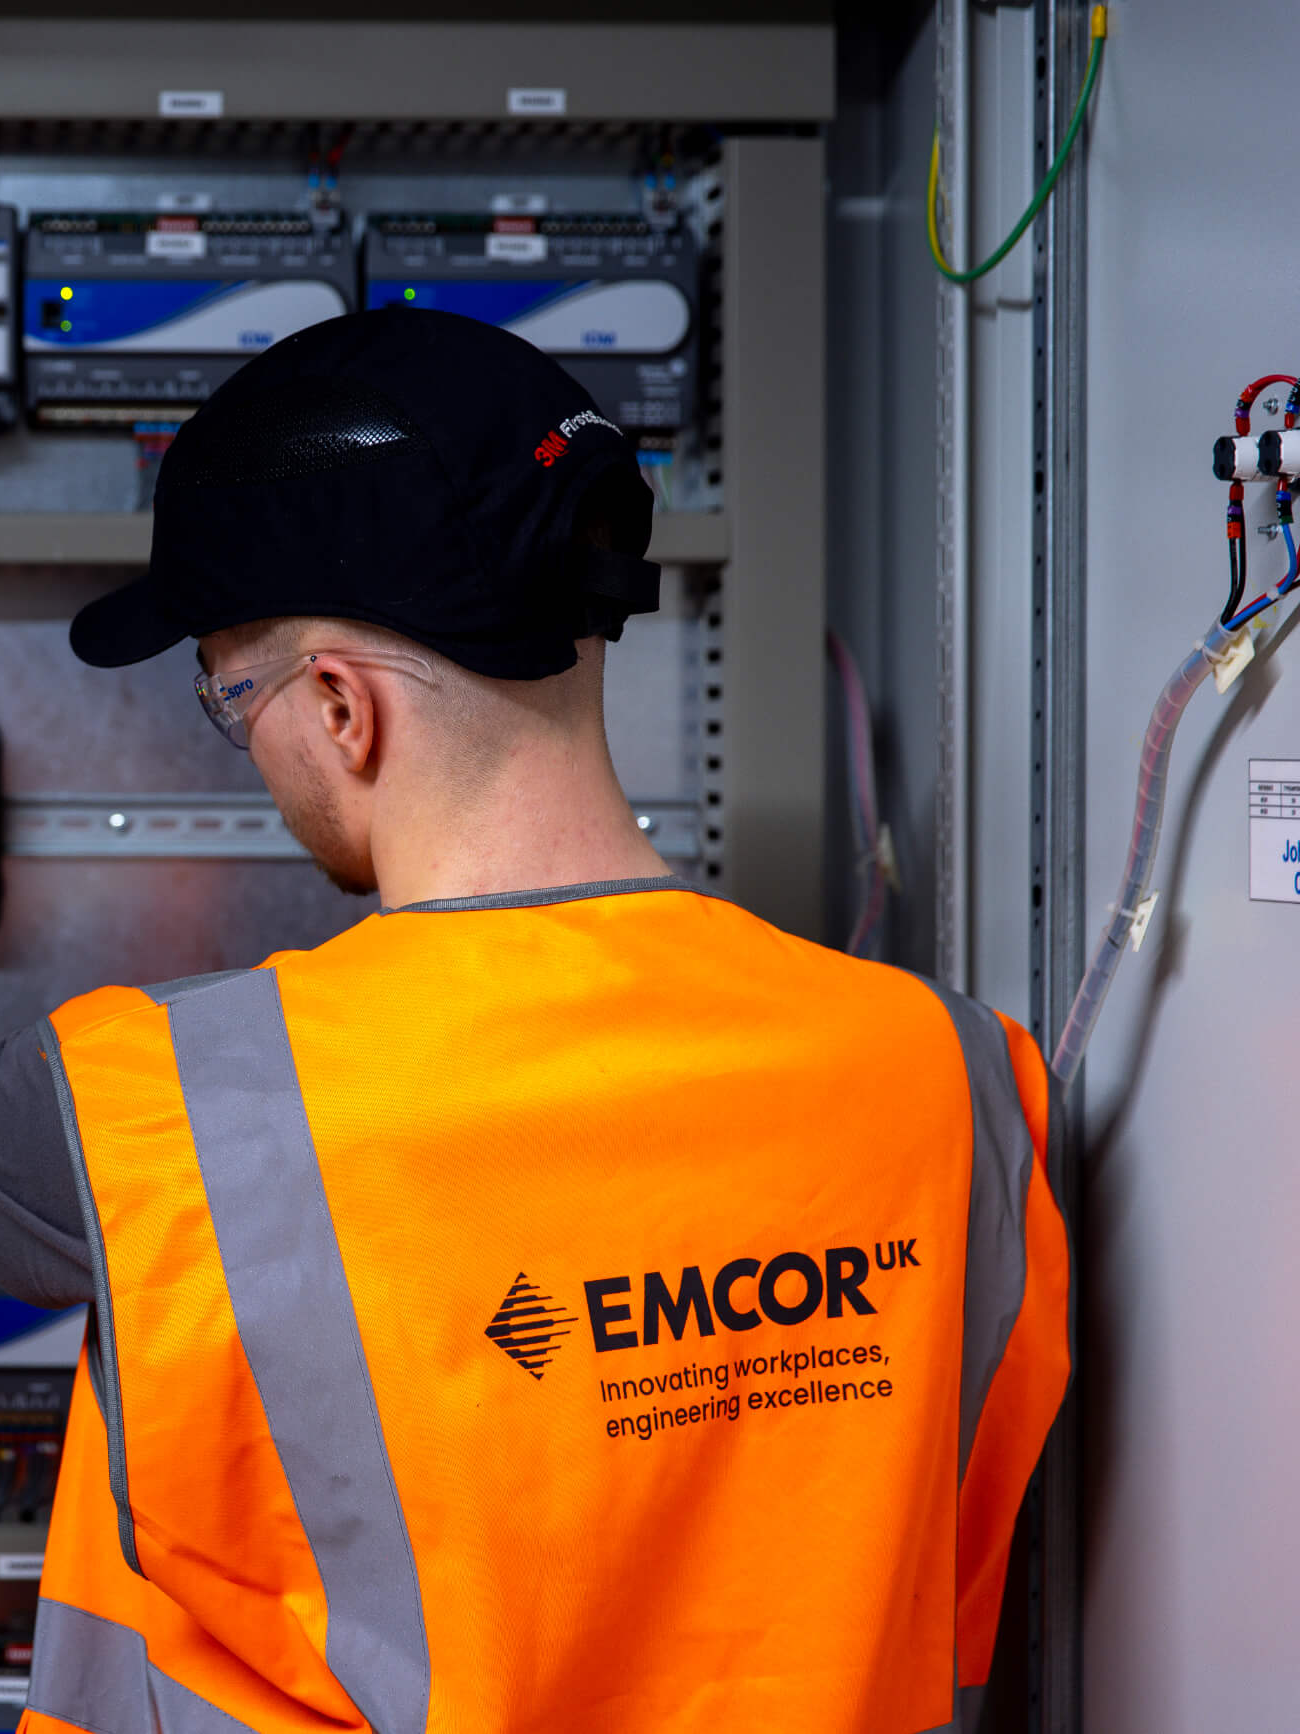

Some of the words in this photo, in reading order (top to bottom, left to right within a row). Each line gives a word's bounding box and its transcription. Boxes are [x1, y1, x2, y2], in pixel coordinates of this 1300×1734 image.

[534, 430, 570, 468] 3M
[584, 1246, 878, 1353] EMCOR
[875, 1238, 922, 1271] UK
[600, 1363, 729, 1403] Innovating
[734, 1344, 890, 1378] workplaces,
[606, 1393, 741, 1441] engineering
[747, 1378, 894, 1411] excellence
